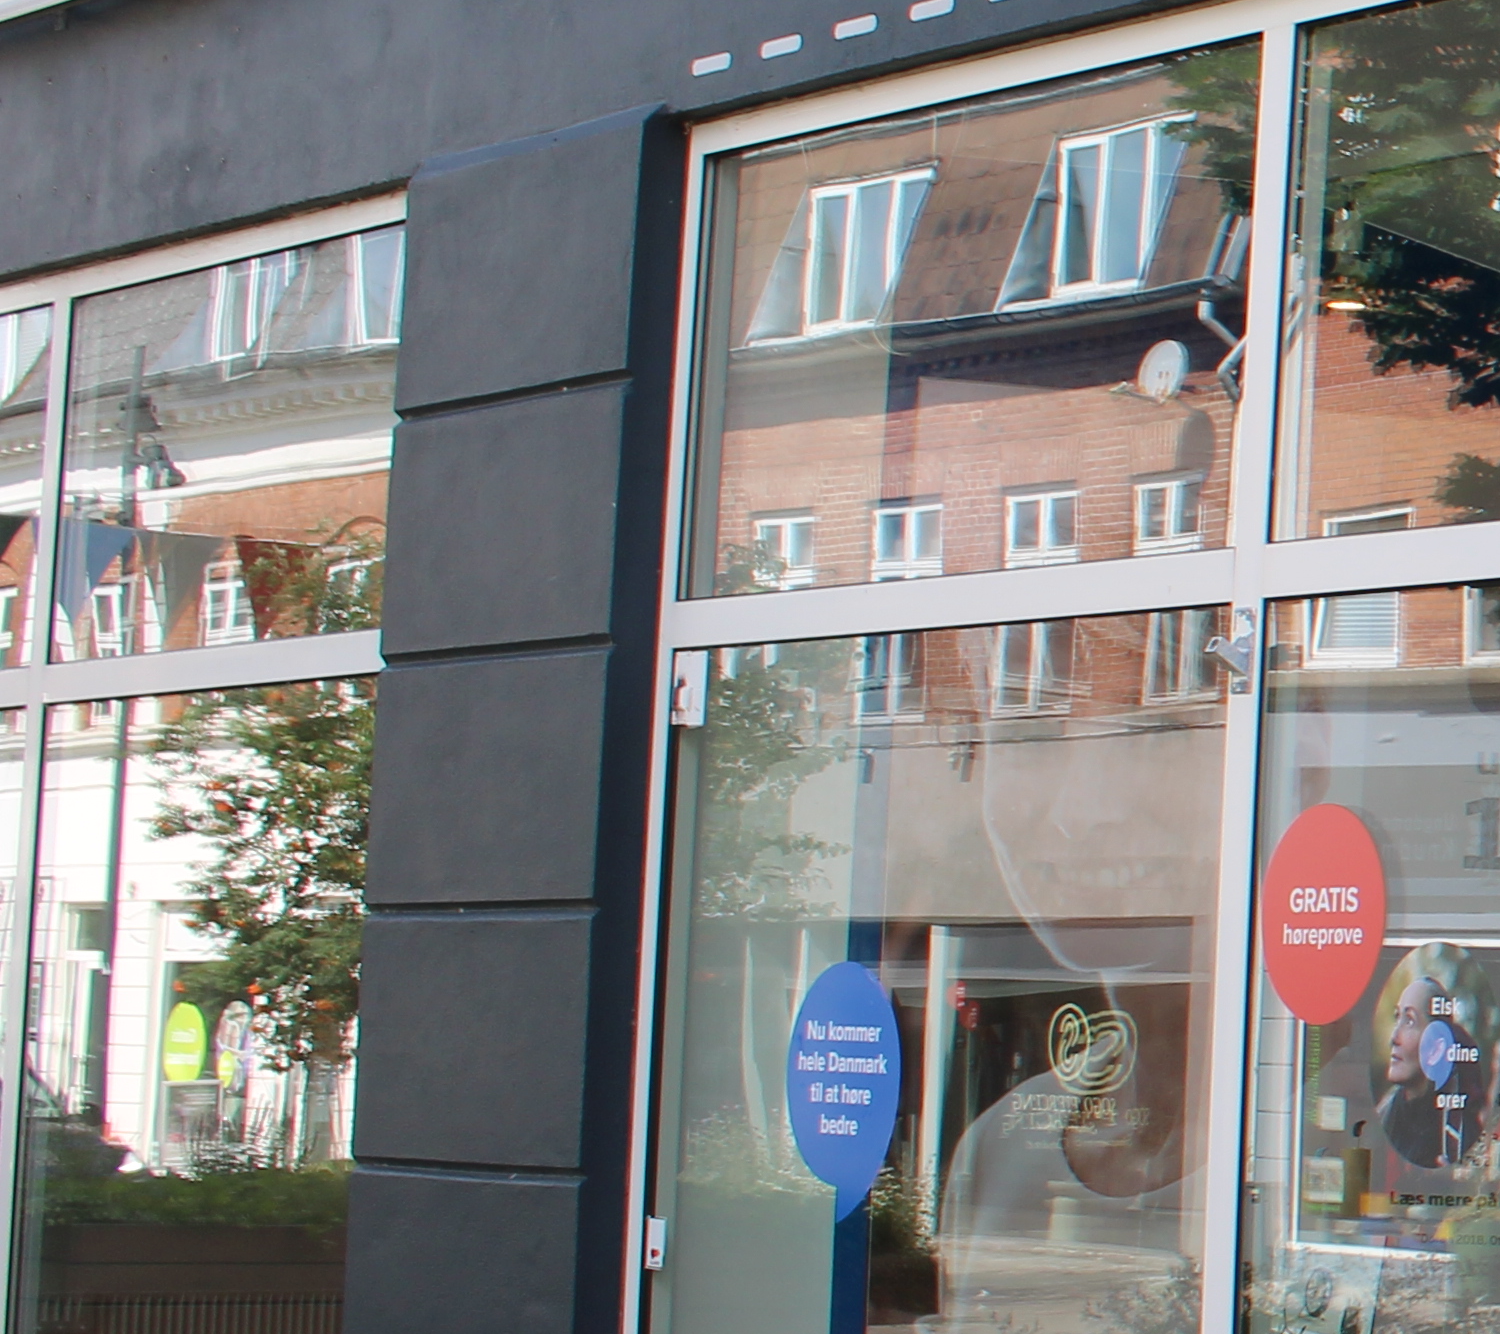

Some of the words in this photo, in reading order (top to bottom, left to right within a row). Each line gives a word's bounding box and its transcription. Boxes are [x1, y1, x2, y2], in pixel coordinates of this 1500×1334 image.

[1289, 886, 1359, 913] GRATIS
[1282, 923, 1363, 950] høreprøve
[1431, 997, 1461, 1016] Elsk
[806, 1019, 826, 1040] Nu
[828, 1021, 882, 1042] kommer
[798, 1050, 826, 1072] hele
[828, 1051, 888, 1074] Danmark
[1446, 1044, 1479, 1063] dine
[810, 1082, 823, 1103] til
[825, 1084, 839, 1104] at
[841, 1083, 872, 1105] høre
[1436, 1091, 1467, 1110] ører
[820, 1113, 859, 1136] bedre
[1390, 1191, 1425, 1207] Læs
[1428, 1193, 1473, 1207] mere
[1476, 1191, 1498, 1210] på
